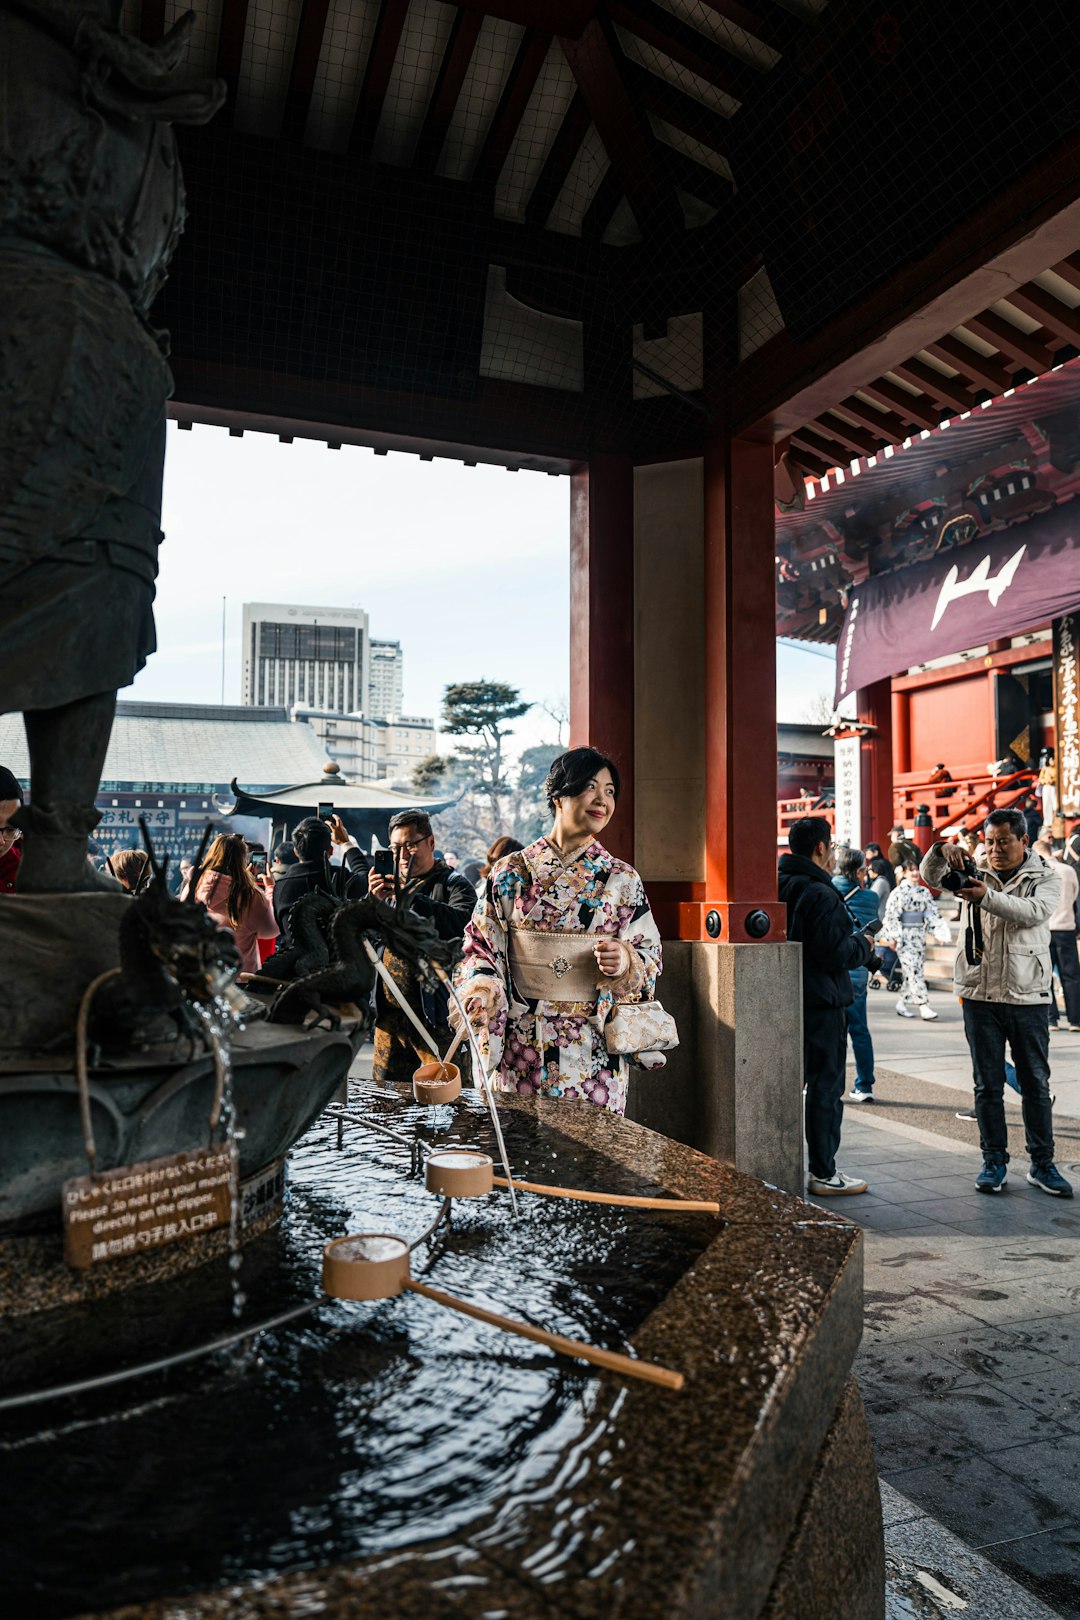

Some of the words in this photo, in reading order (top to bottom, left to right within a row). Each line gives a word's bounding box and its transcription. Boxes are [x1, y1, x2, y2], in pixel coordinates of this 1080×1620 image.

[69, 1203, 109, 1224] Please
[110, 1199, 127, 1214] do
[127, 1194, 149, 1208] not
[149, 1188, 170, 1207] put
[171, 1181, 197, 1200] your
[92, 1212, 138, 1235] directly
[138, 1208, 155, 1222] on
[155, 1202, 176, 1217] the
[176, 1192, 216, 1212] dipper.
